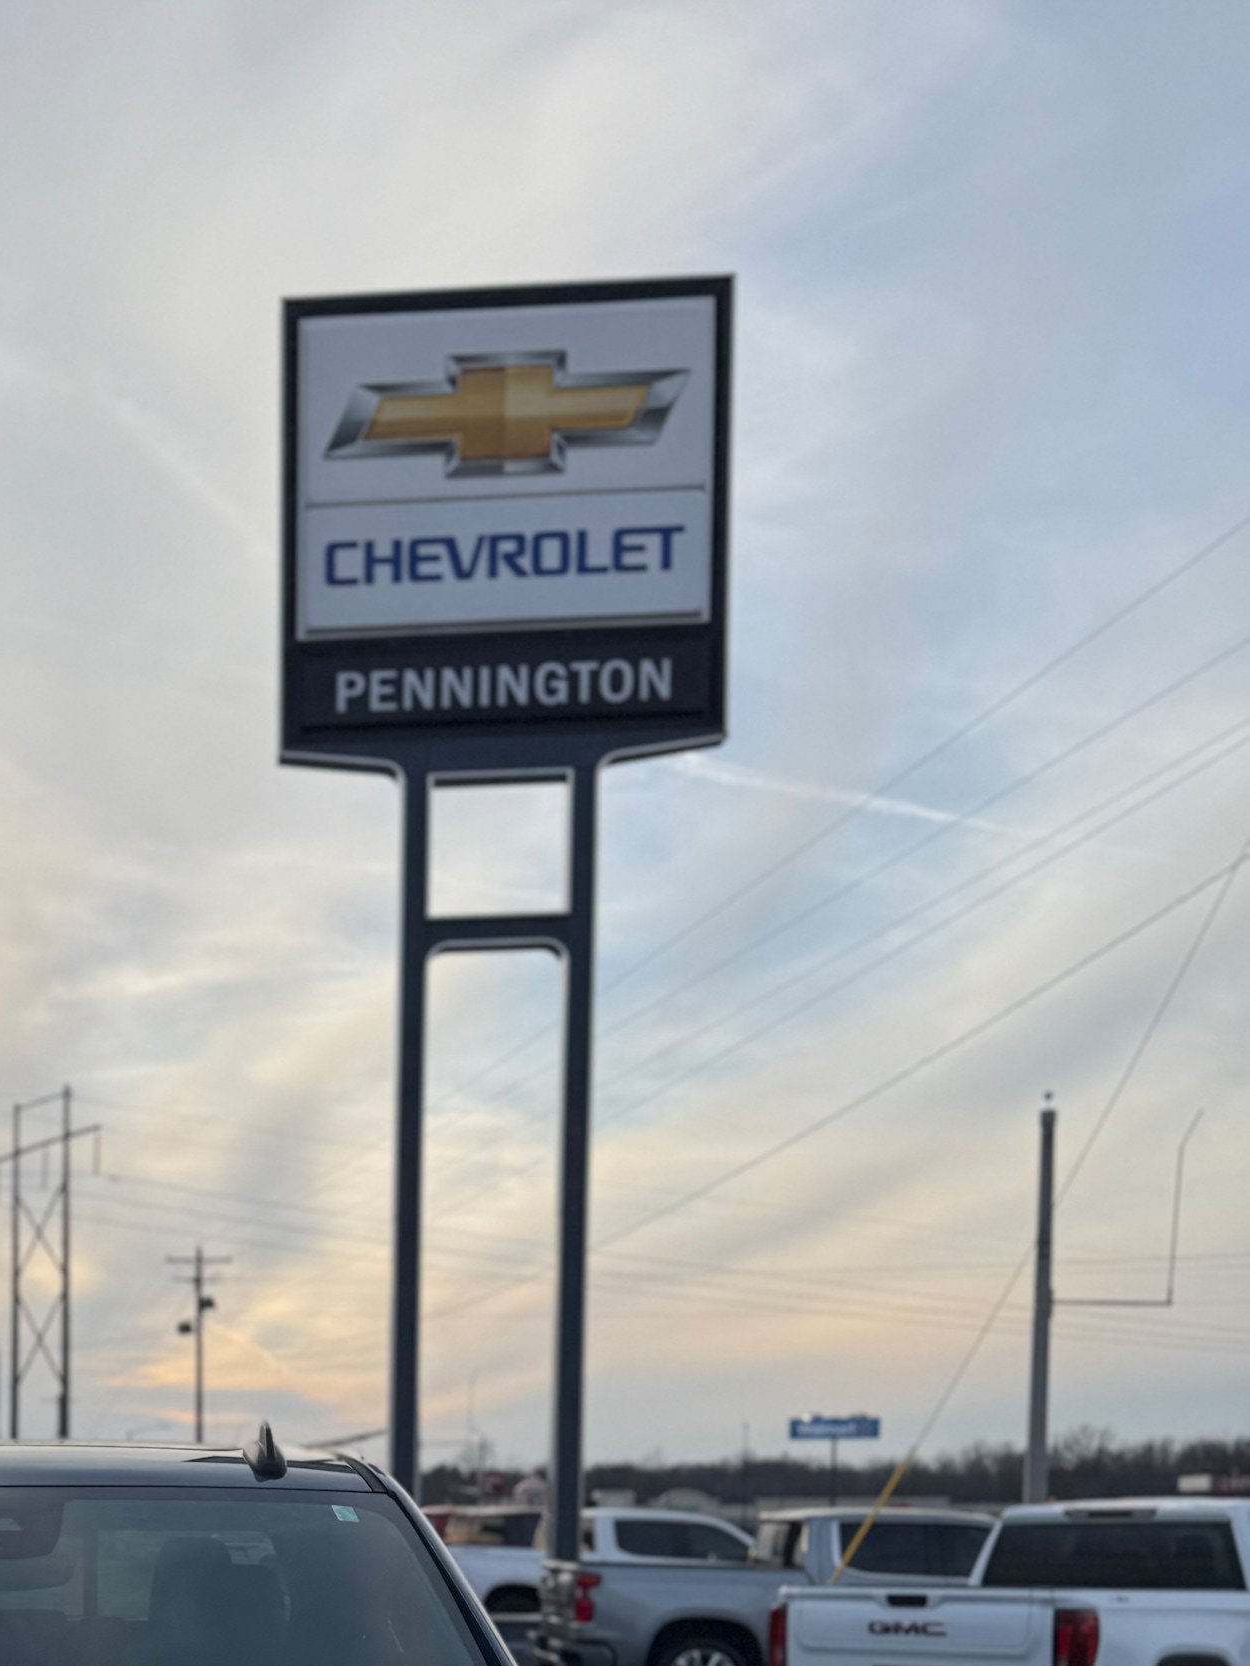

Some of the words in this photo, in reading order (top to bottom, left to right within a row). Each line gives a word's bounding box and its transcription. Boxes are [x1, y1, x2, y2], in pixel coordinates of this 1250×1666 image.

[324, 525, 685, 588] CHEVROLET
[336, 657, 674, 713] PENNINGTON
[868, 1620, 947, 1637] GMC
